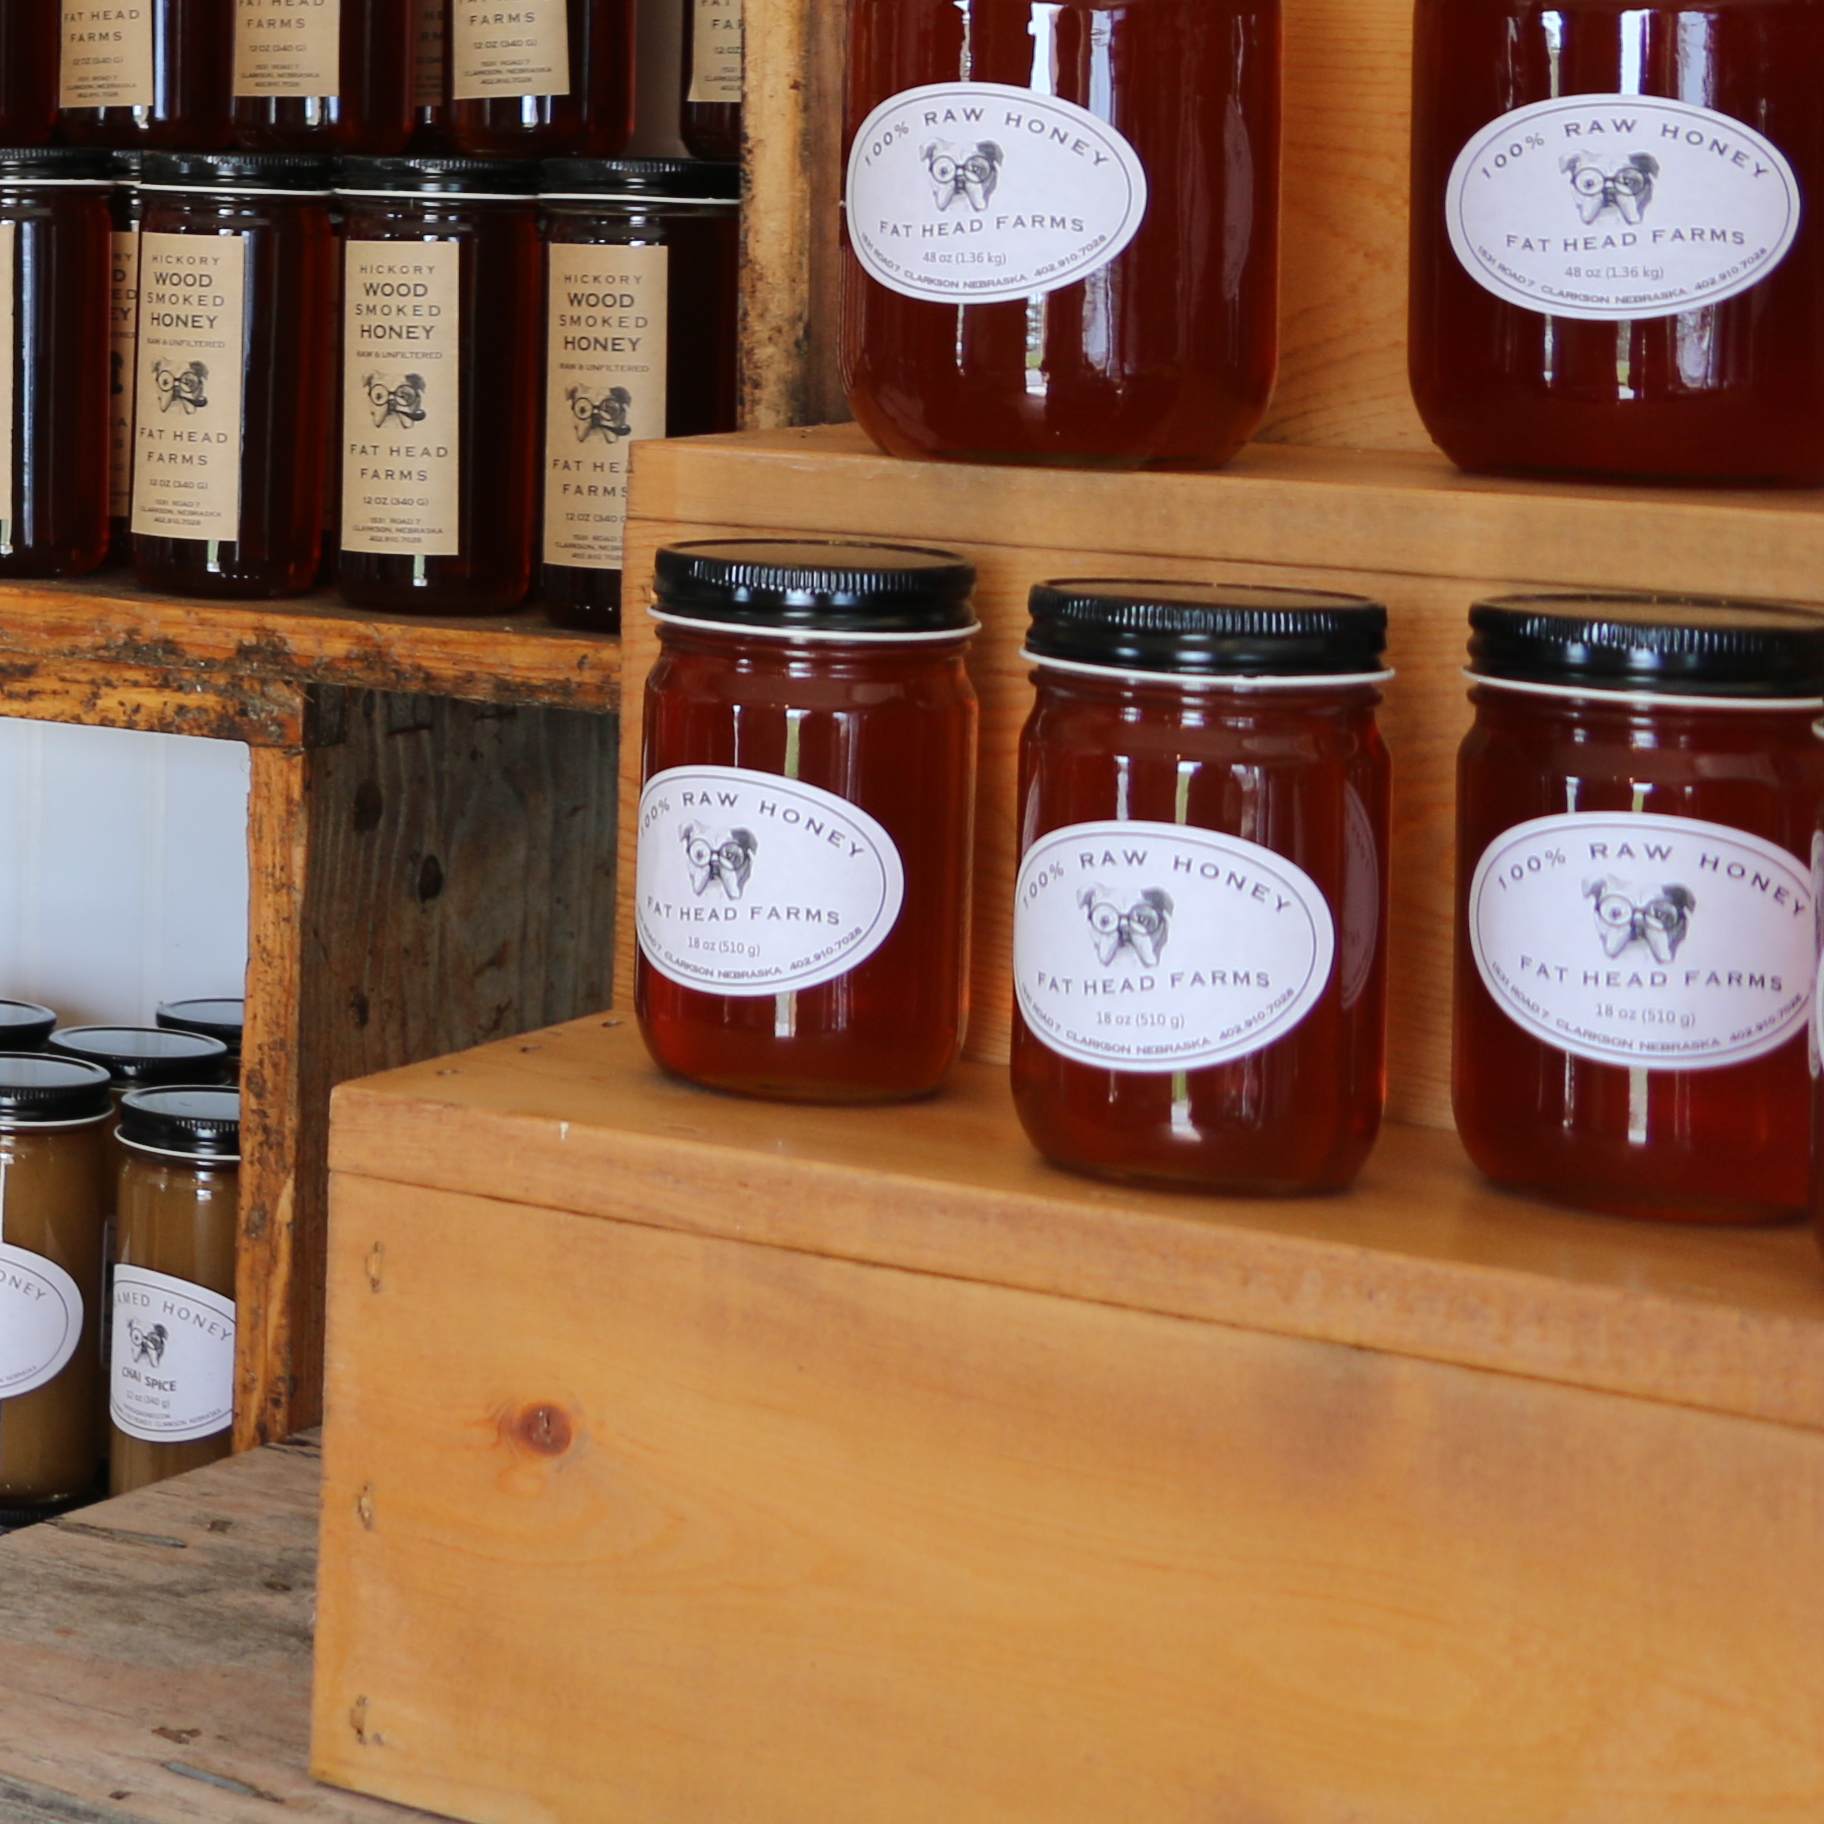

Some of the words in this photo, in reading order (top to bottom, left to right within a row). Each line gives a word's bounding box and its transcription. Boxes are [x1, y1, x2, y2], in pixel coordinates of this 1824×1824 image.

[247, 18, 306, 29] FARMS
[470, 12, 536, 26] FARMS
[864, 121, 909, 166] 100%
[923, 107, 984, 126] RAW
[1005, 111, 1109, 168] HONEY
[1482, 133, 1544, 179] 100%
[1564, 119, 1637, 137] RAW
[1660, 123, 1769, 178] HONEY
[879, 220, 912, 238] FAT
[922, 218, 983, 238] HEAD
[996, 214, 1084, 232] FARMS
[1506, 234, 1550, 252] FAT
[1563, 233, 1637, 251] HEAD
[1651, 228, 1745, 244] FARMS
[922, 252, 936, 263] 48
[939, 255, 953, 263] oz
[955, 251, 984, 265] (1.36
[987, 252, 1006, 266] kg)
[360, 265, 436, 275] HICKORY
[1565, 266, 1581, 278] 48
[1585, 269, 1601, 278] oz
[1606, 266, 1638, 279] (1.36
[1642, 266, 1664, 280] kg)
[363, 283, 428, 297] WOOD
[355, 304, 442, 317] SMOKED
[360, 325, 436, 340] HONEY
[350, 444, 380, 457] FAT
[389, 446, 448, 458] HEAD
[360, 468, 429, 481] FARMS
[682, 791, 739, 808] RAW
[759, 800, 865, 859] HONEY
[1023, 861, 1064, 909] 100%
[1079, 849, 1148, 869] RAW
[1173, 855, 1291, 914] HONEY
[1498, 848, 1566, 891] 100%
[1588, 842, 1673, 861] RAW
[1699, 853, 1806, 918] HONEY
[647, 896, 672, 919] FAT
[680, 907, 737, 922] HEAD
[750, 906, 840, 926] FARMS
[688, 936, 699, 949] 18
[702, 941, 716, 952] oz
[718, 940, 745, 953] (510
[748, 944, 760, 957] g)
[1037, 970, 1072, 994] FAT
[1084, 975, 1155, 995] HEAD
[1170, 970, 1270, 988] FARMS
[1520, 955, 1569, 983] FAT
[1583, 970, 1668, 989] HEAD
[1684, 970, 1783, 992] FARMS
[1096, 1012, 1111, 1025] 18
[1115, 1015, 1131, 1026] oz
[1135, 1012, 1165, 1027] (510
[1170, 1013, 1185, 1029] g)
